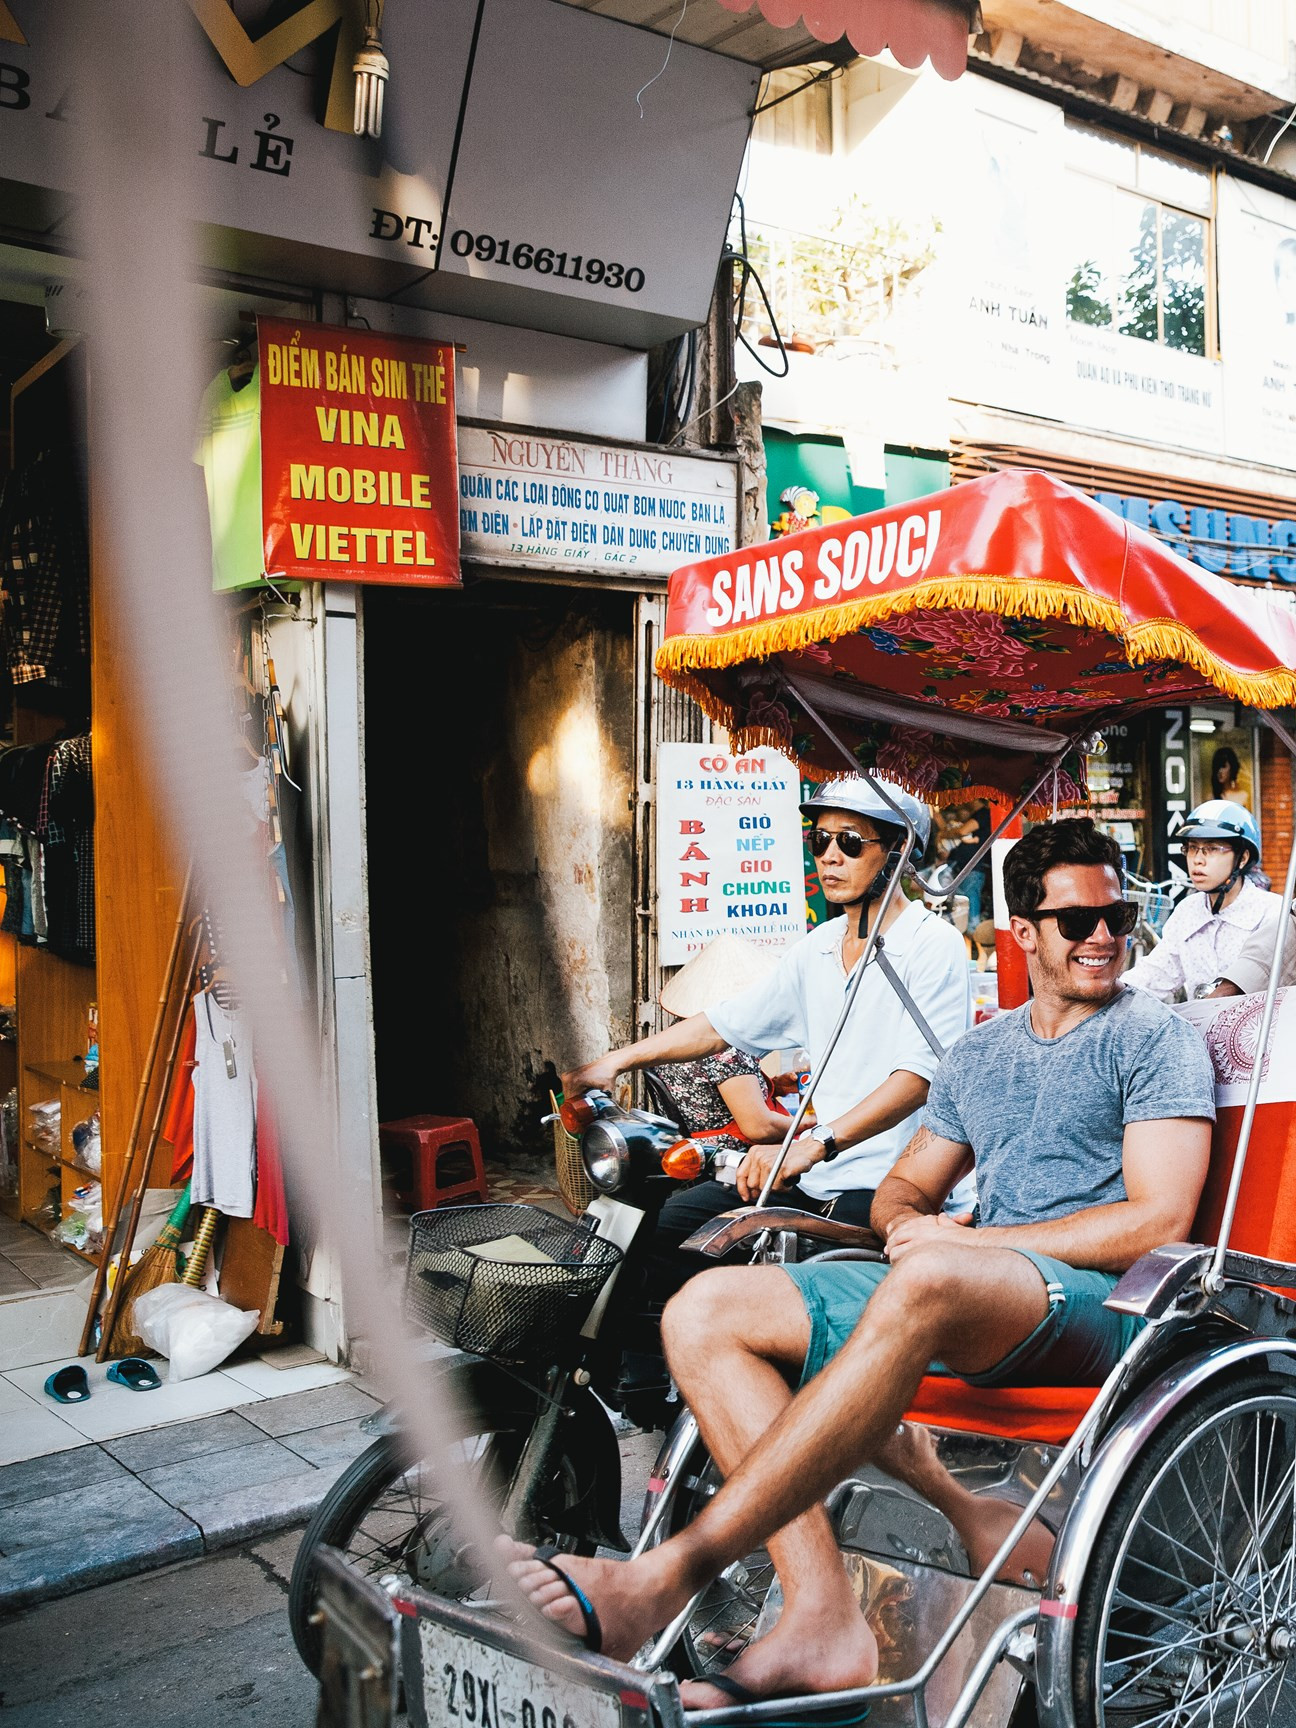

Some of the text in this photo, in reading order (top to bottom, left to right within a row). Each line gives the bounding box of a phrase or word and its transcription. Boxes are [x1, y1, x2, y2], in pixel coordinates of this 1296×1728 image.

[369, 208, 646, 292] ĐT: 0916611930
[969, 296, 1001, 318] ANH
[267, 330, 447, 405] ĐIỂM BÁN SIM THẺ
[315, 406, 406, 450] VINA
[290, 463, 432, 509] MOBILE
[496, 475, 519, 503] CÁC
[523, 482, 548, 508] LOẠI
[290, 523, 435, 567] VIETTEL
[603, 522, 624, 547] DÂN
[510, 543, 523, 553] 13
[629, 555, 638, 564] 2
[706, 510, 942, 628] SANS SOUCI
[699, 754, 767, 775] CÔ AN
[676, 779, 694, 790] 13
[701, 777, 745, 791] HÀNG
[1164, 709, 1189, 900] NOKIA
[738, 813, 772, 830] GIÒ
[736, 833, 776, 852] NẾP
[678, 820, 711, 914] BÁNH
[727, 903, 788, 918] KHOAI
